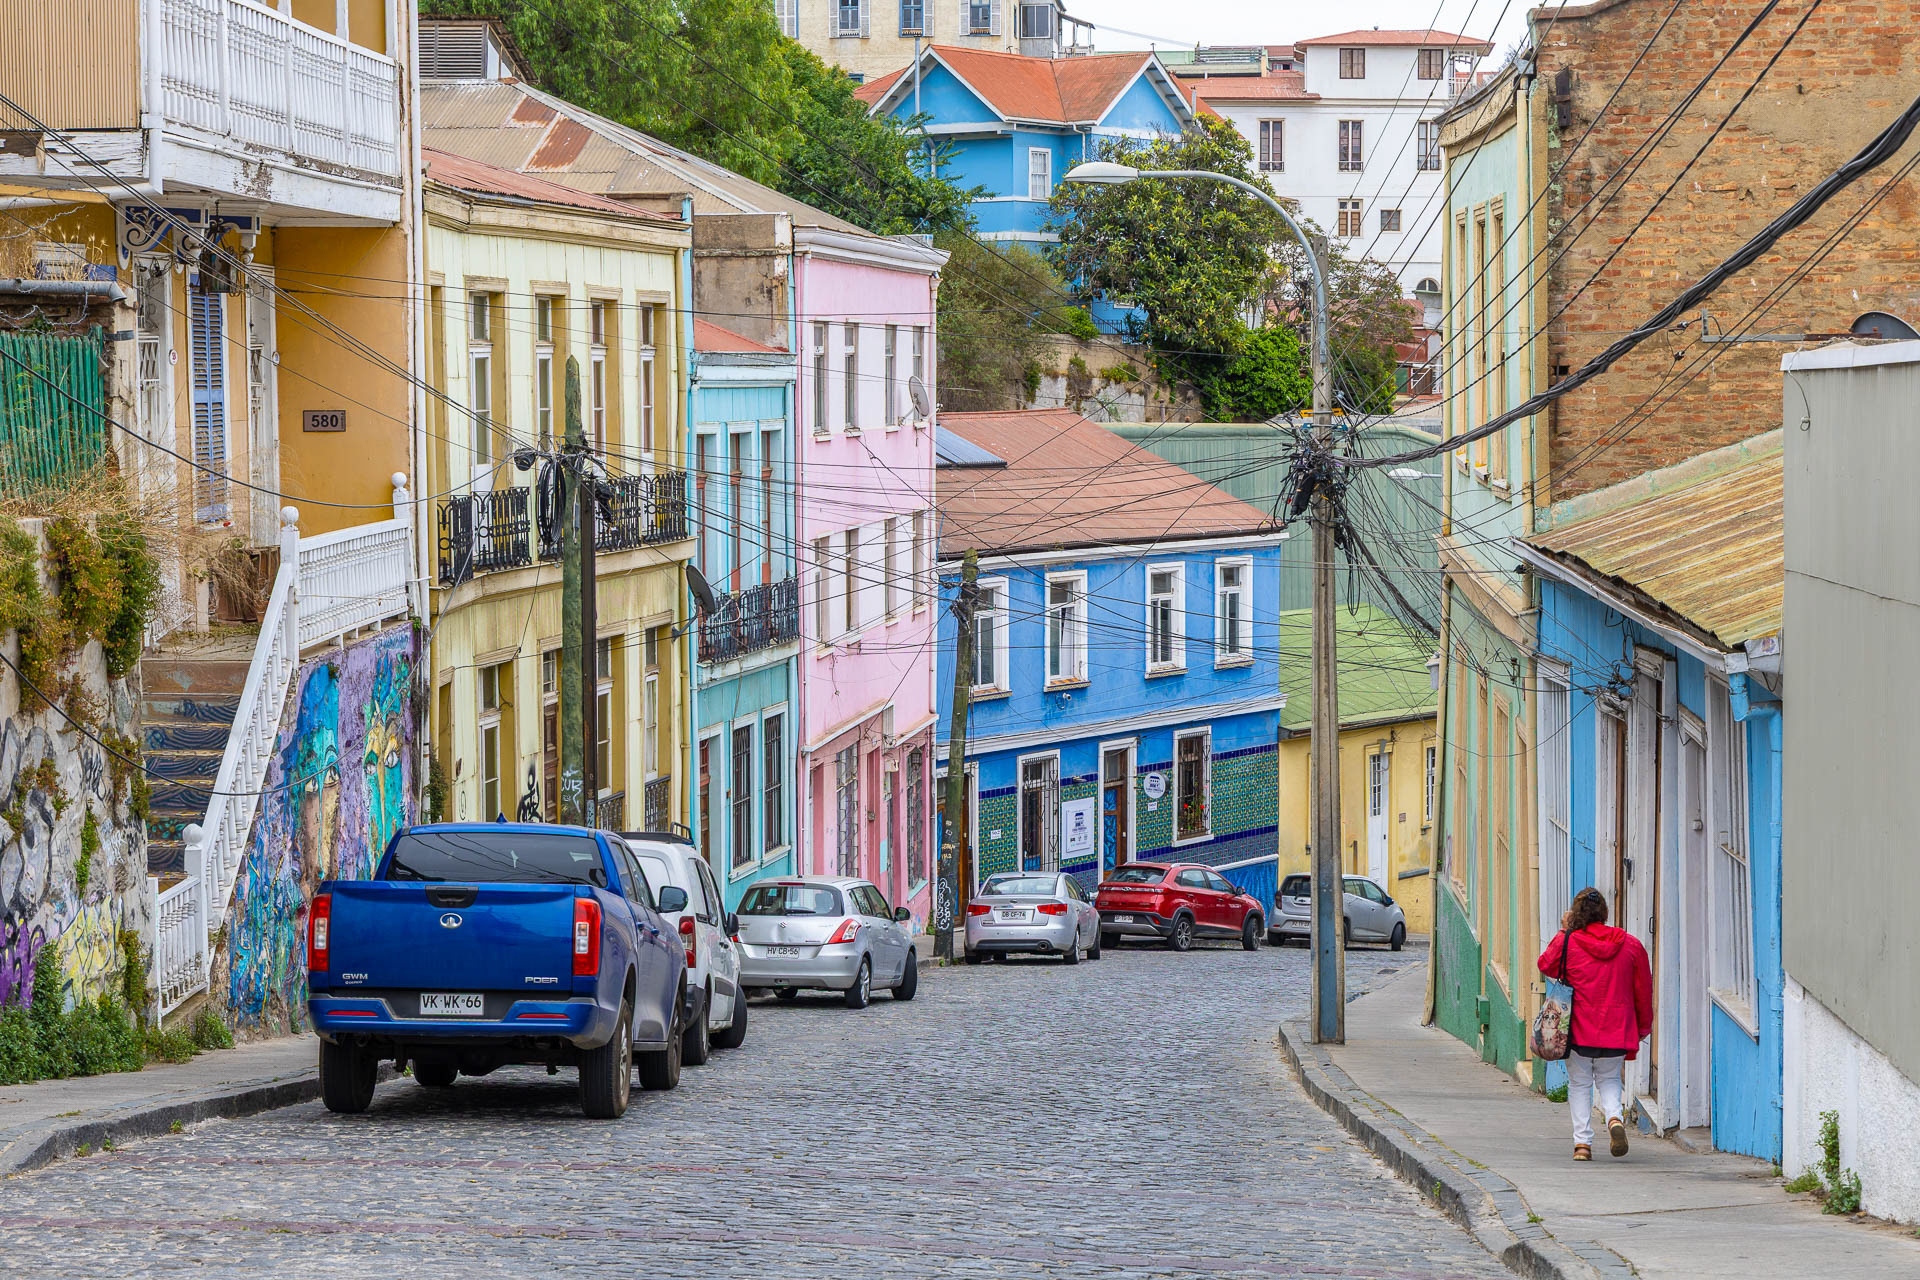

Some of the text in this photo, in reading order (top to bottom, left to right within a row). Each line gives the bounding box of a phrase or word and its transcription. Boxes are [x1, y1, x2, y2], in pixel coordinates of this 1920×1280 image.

[311, 414, 339, 428] 580
[767, 947, 777, 955] HV
[525, 976, 558, 984] POER
